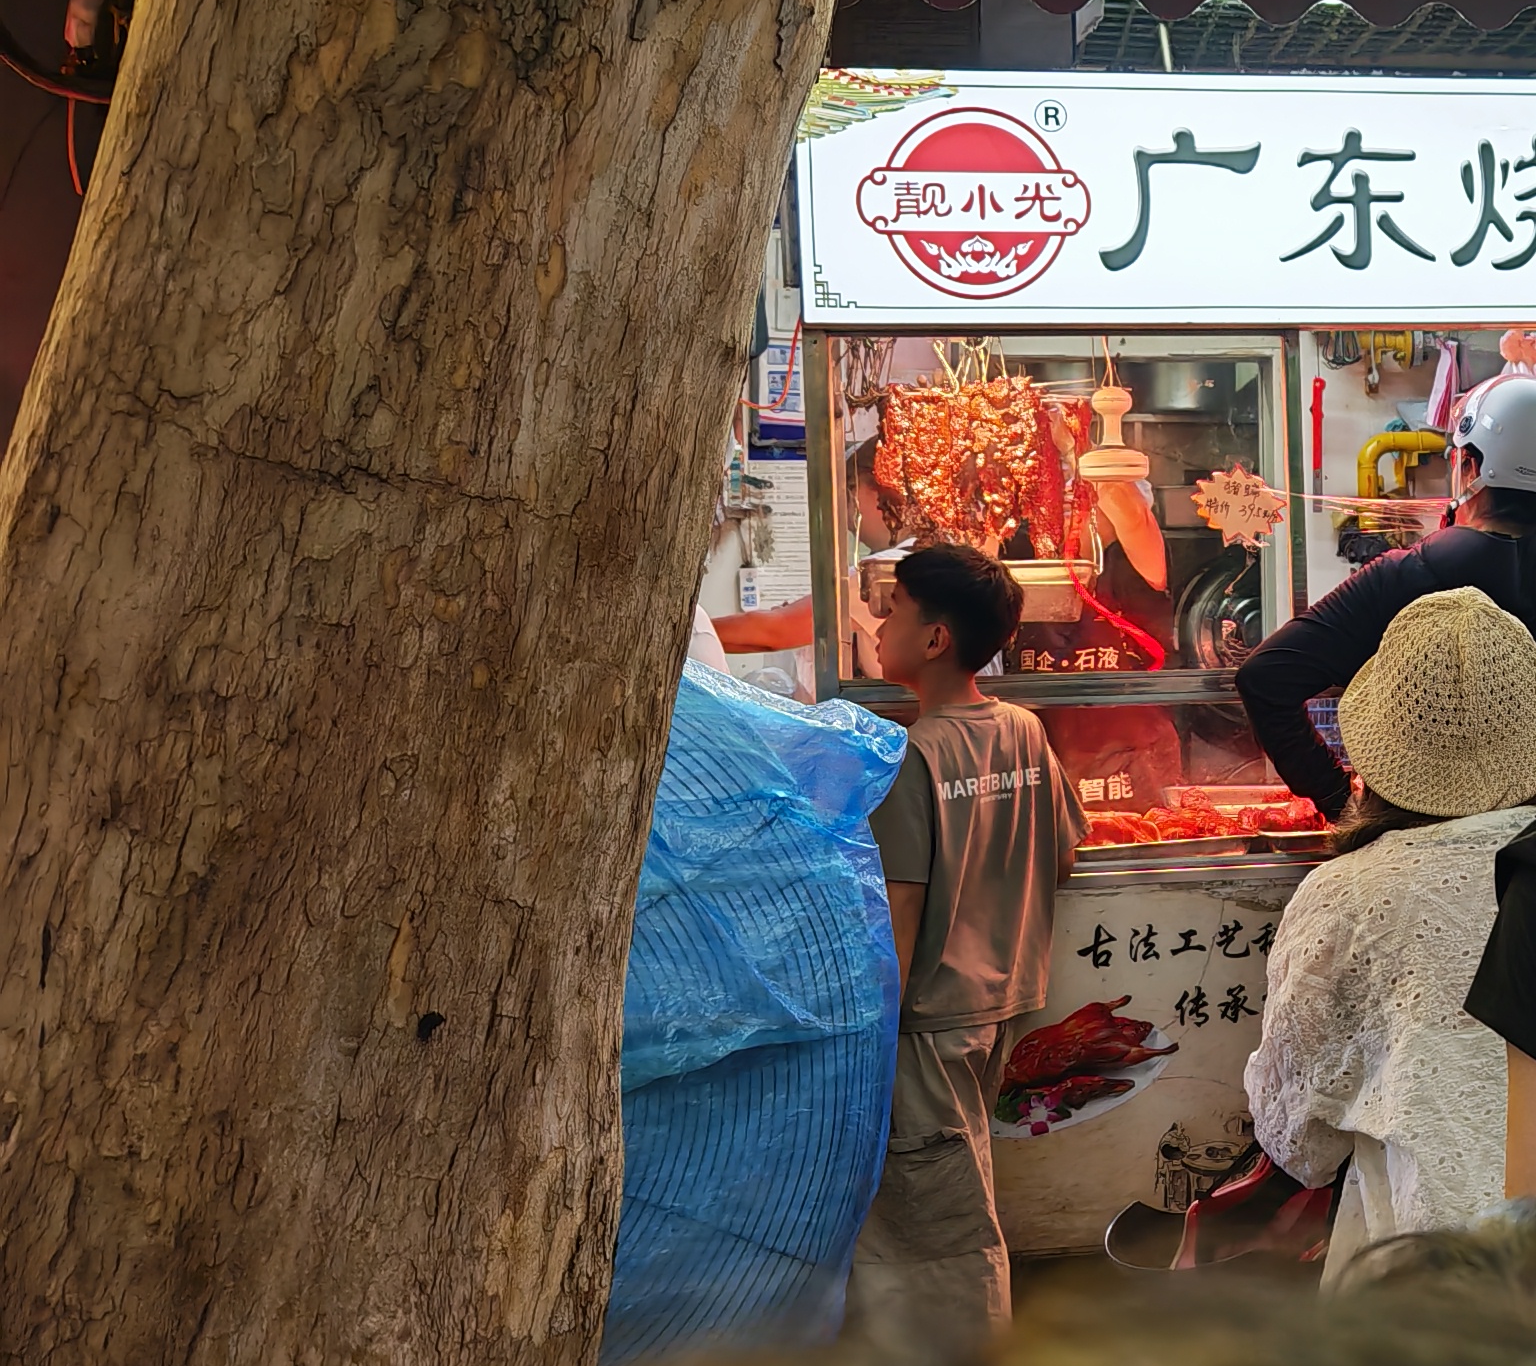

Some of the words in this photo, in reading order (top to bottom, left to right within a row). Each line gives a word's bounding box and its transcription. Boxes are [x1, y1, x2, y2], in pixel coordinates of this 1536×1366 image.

[890, 181, 1063, 225] 靓小光
[1078, 771, 1134, 803] 智能
[1174, 983, 1268, 1029] 传承
